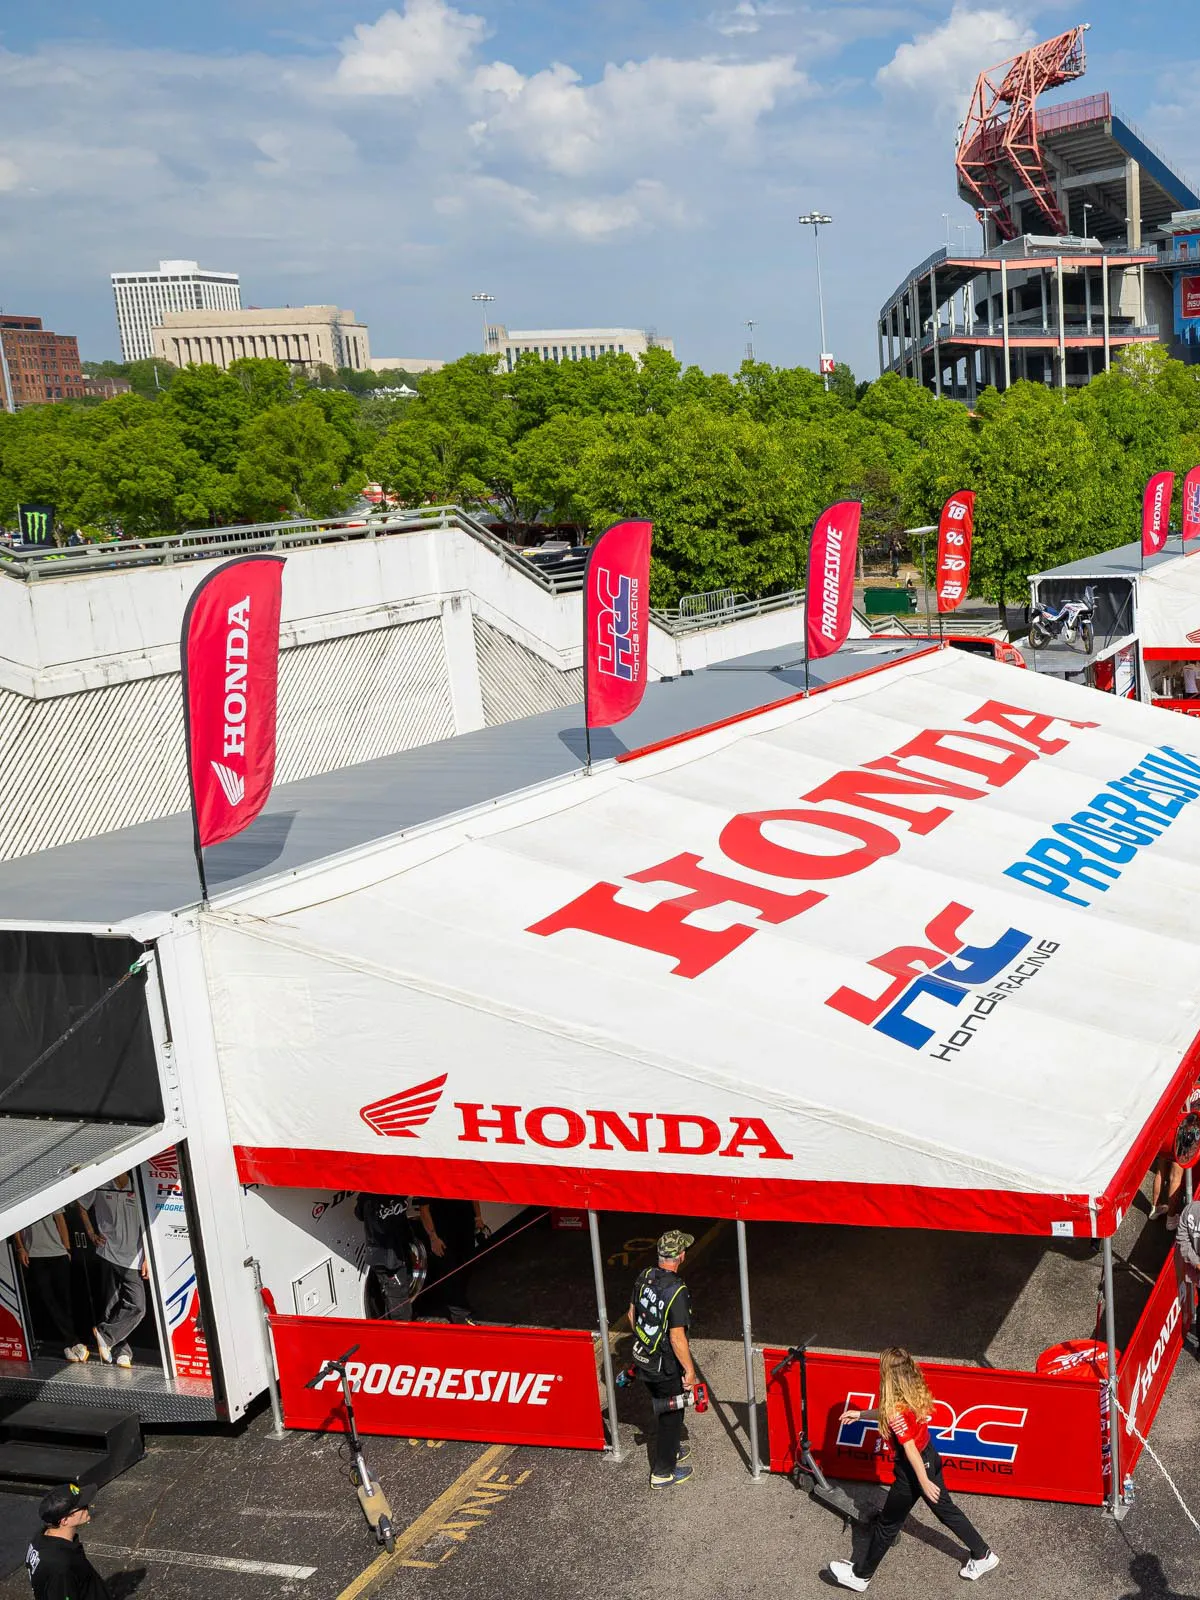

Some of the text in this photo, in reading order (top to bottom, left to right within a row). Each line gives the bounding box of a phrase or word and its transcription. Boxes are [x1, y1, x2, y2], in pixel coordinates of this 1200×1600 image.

[1187, 292, 1200, 300] Farm
[823, 359, 832, 372] K
[948, 505, 967, 520] 18
[1153, 481, 1164, 531] HONDA
[945, 531, 964, 546] 96
[820, 523, 843, 643] PROGRESSIVE
[941, 559, 966, 571] 30
[631, 578, 639, 630] RACING
[940, 584, 962, 599] 29
[594, 566, 632, 682] HRC
[222, 595, 252, 758] HONDA
[524, 700, 1100, 979] HONDA
[824, 900, 1033, 1051] HRC
[994, 939, 1061, 1000] RACING
[457, 1101, 794, 1161] HONDA
[643, 1286, 665, 1310] PHOO
[1139, 1297, 1181, 1403] HOND
[313, 1358, 555, 1406] PROGRESSIVE
[943, 1457, 1014, 1475] ACING
